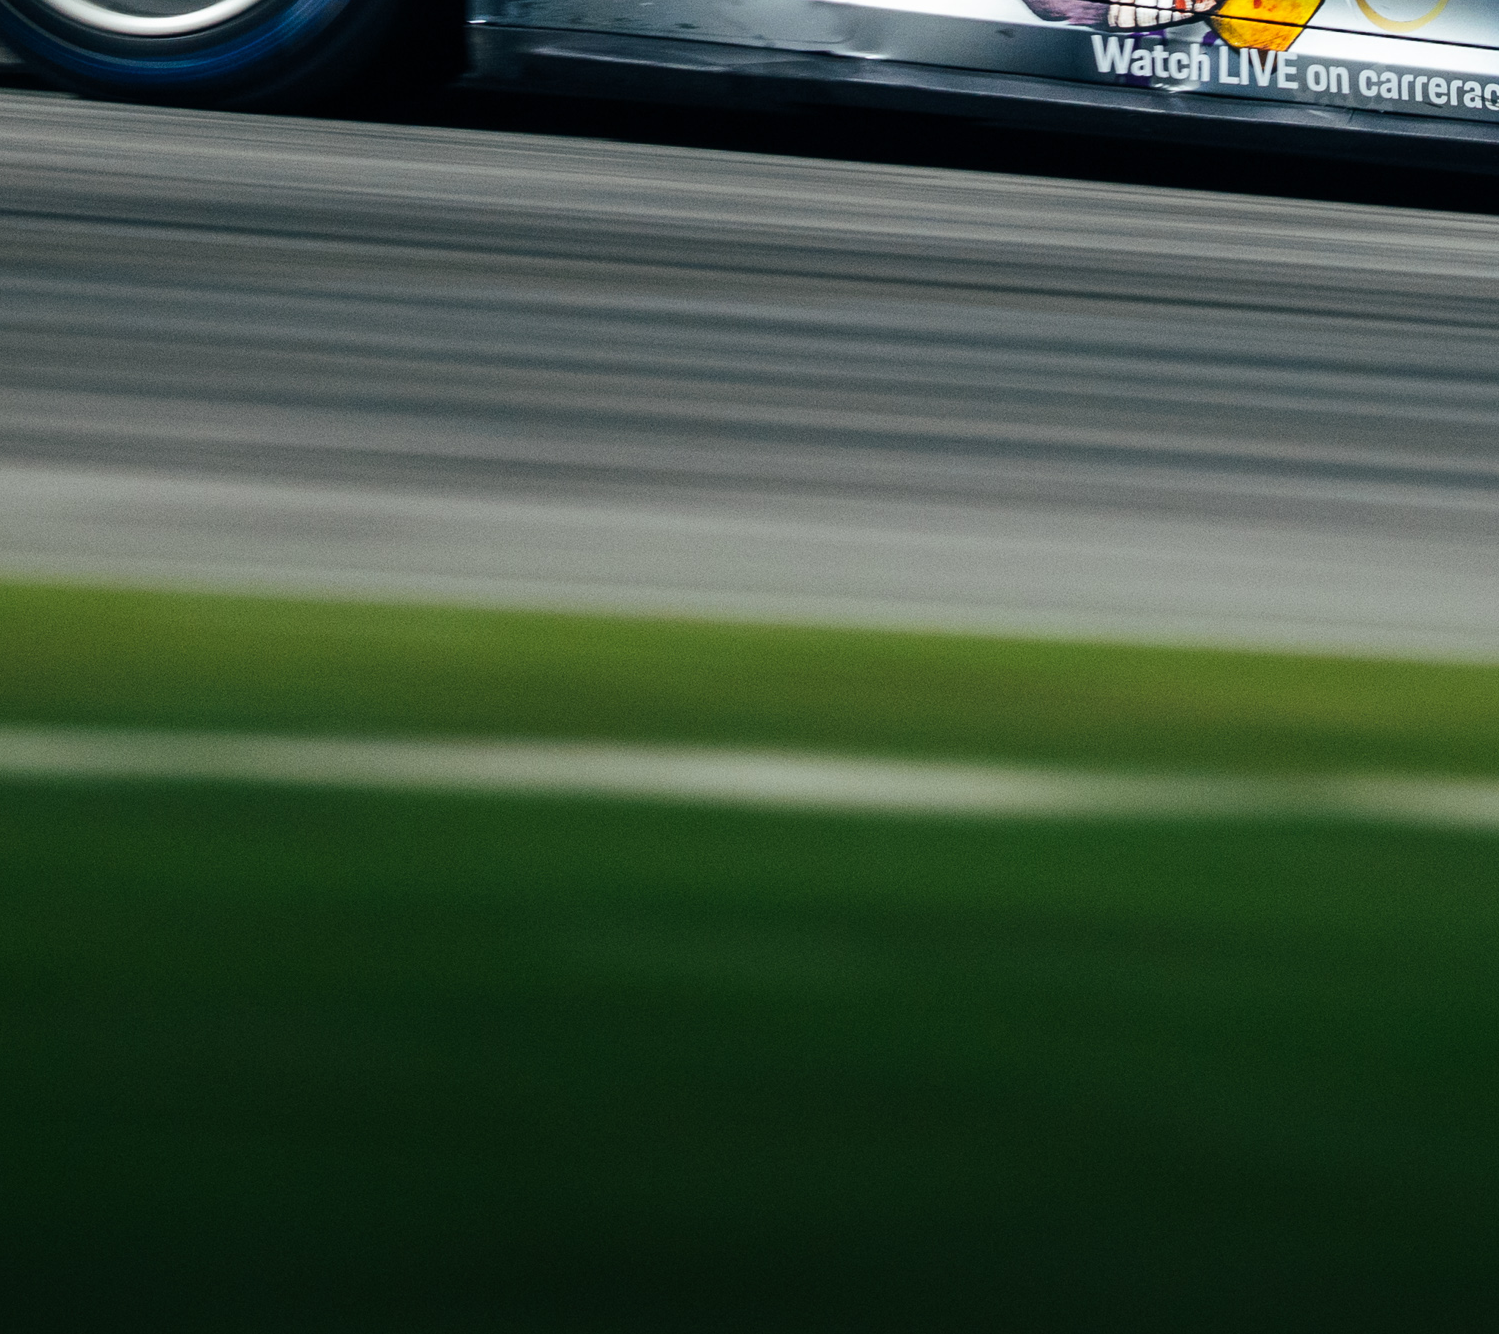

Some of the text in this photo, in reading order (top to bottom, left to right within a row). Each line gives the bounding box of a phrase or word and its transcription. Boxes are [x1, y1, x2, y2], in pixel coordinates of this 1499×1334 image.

[1091, 34, 1211, 82] Watch
[1217, 48, 1299, 90] LIVE
[1305, 63, 1351, 95] on
